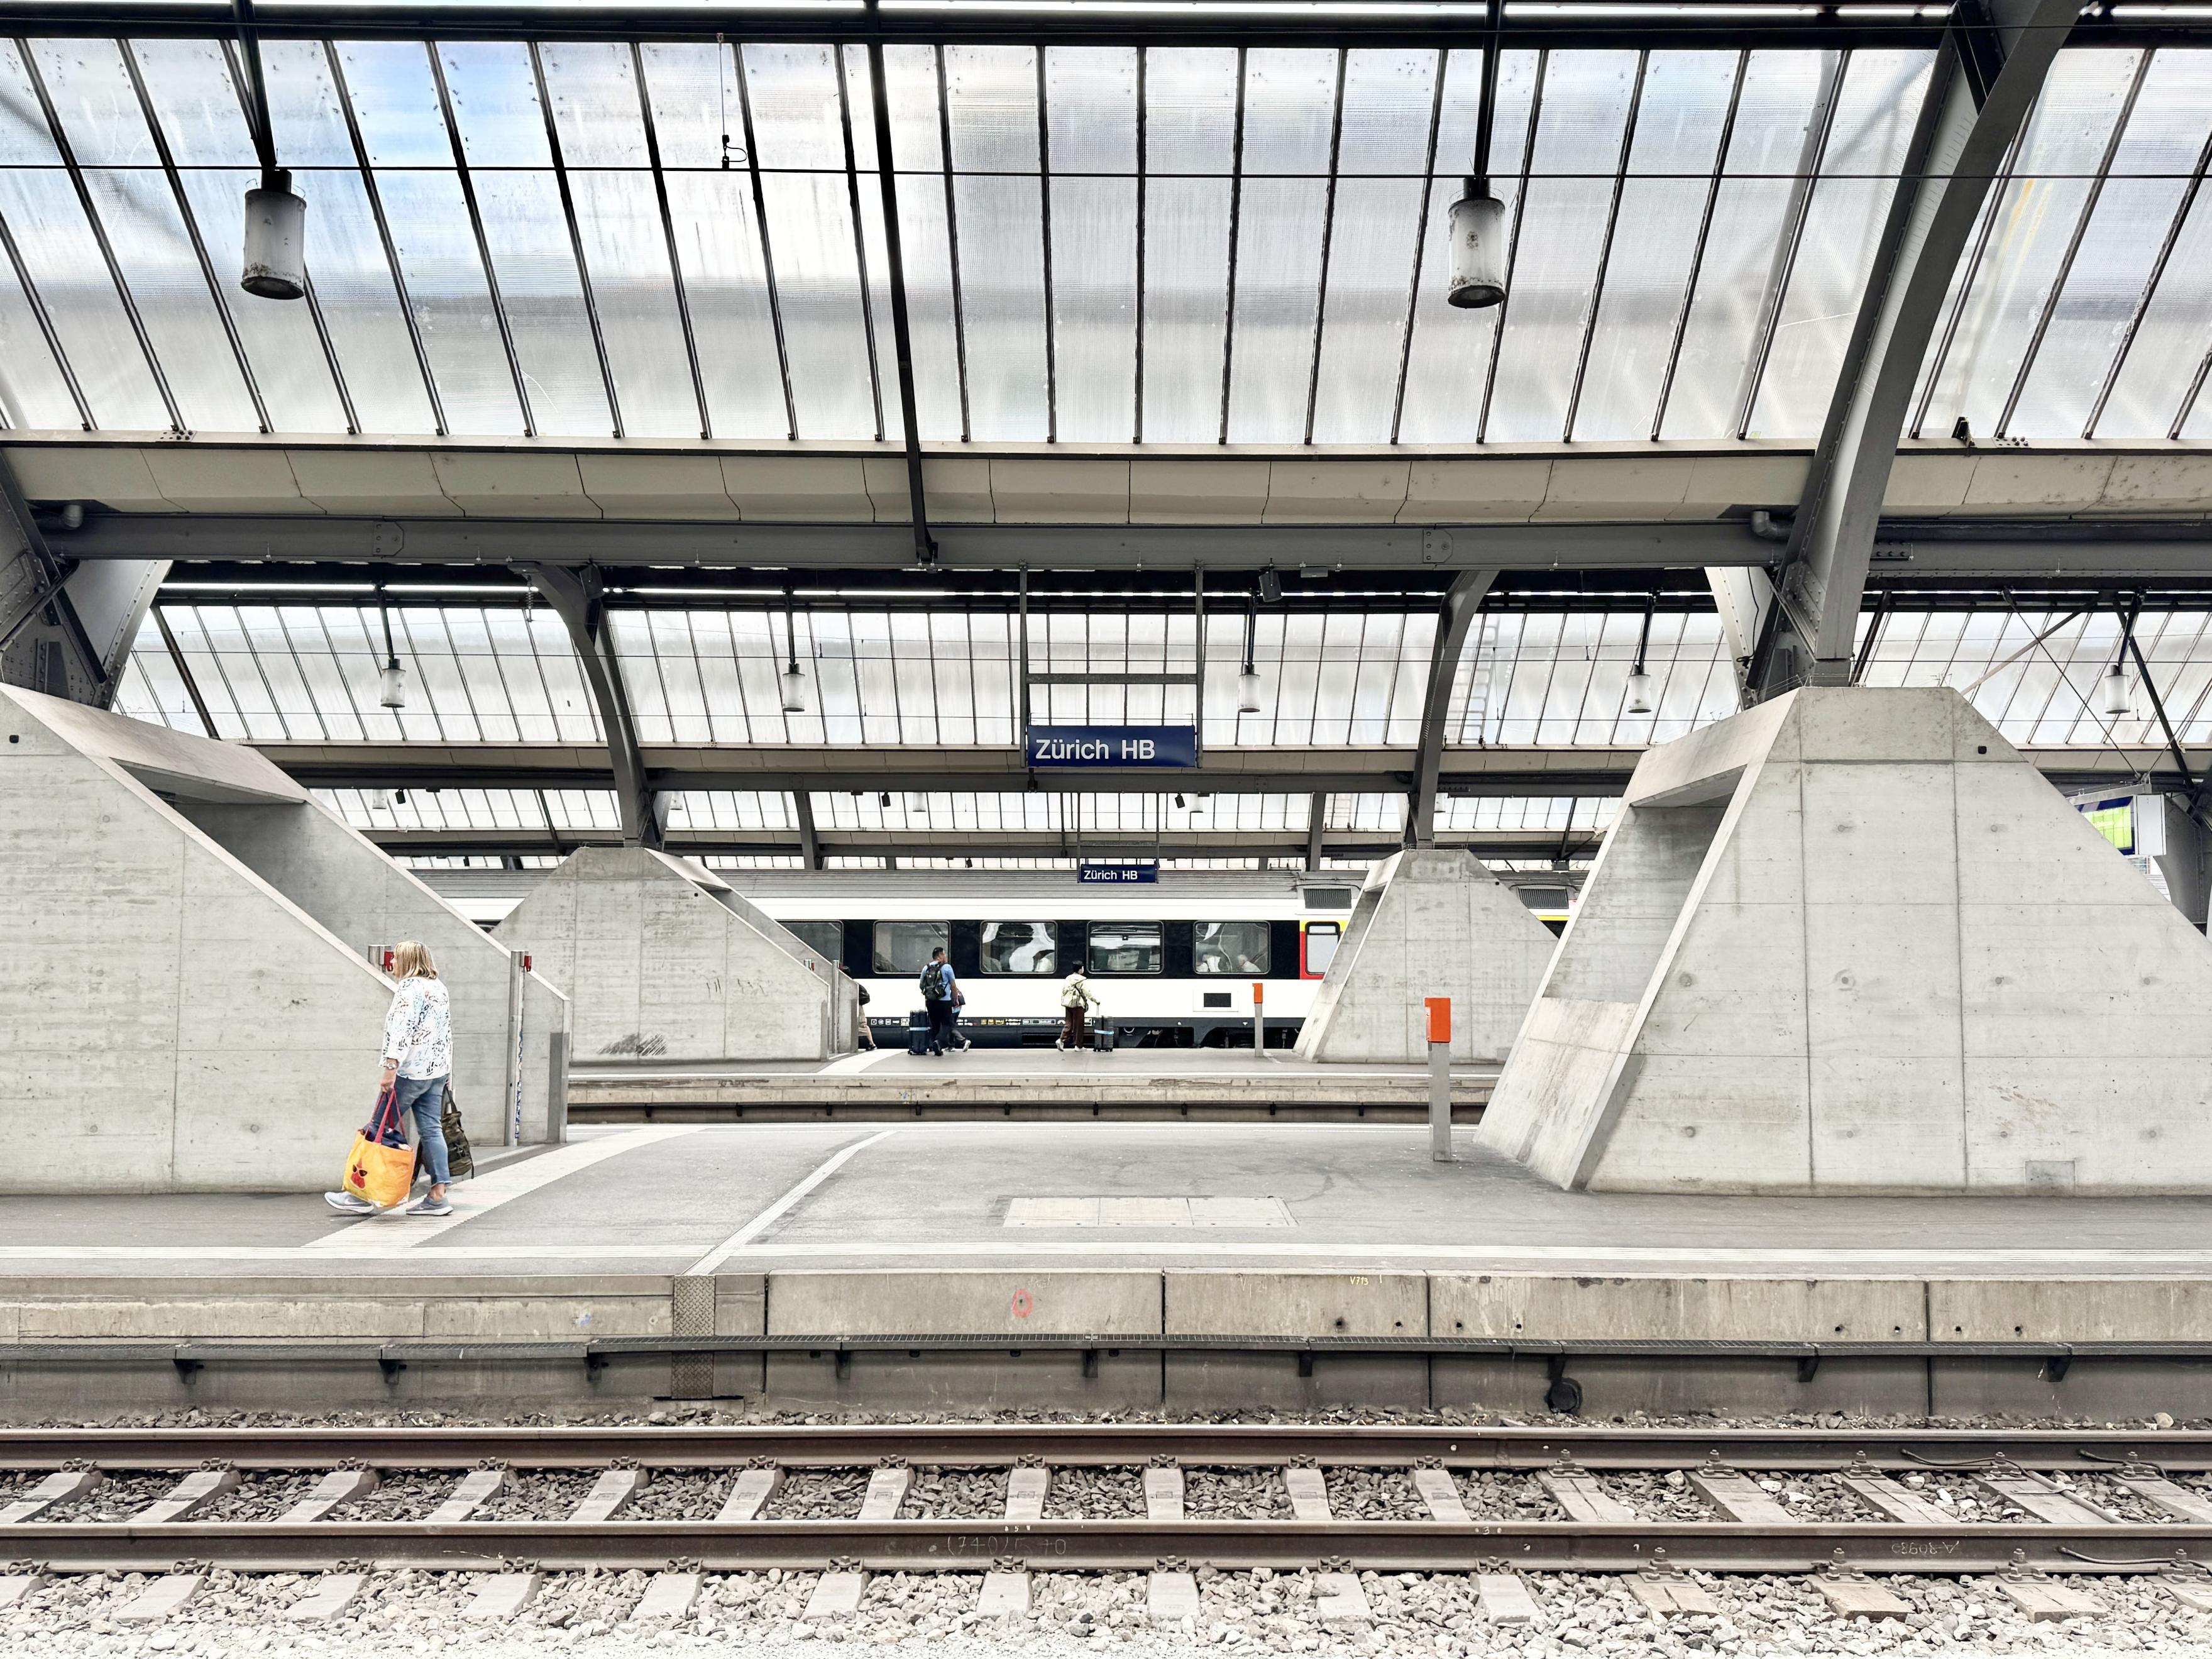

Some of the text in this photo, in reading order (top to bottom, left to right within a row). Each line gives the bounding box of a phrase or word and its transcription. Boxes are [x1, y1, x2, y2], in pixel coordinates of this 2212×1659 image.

[1035, 739, 1155, 759] Zürich HB
[1084, 870, 1138, 880] Zürich HB
